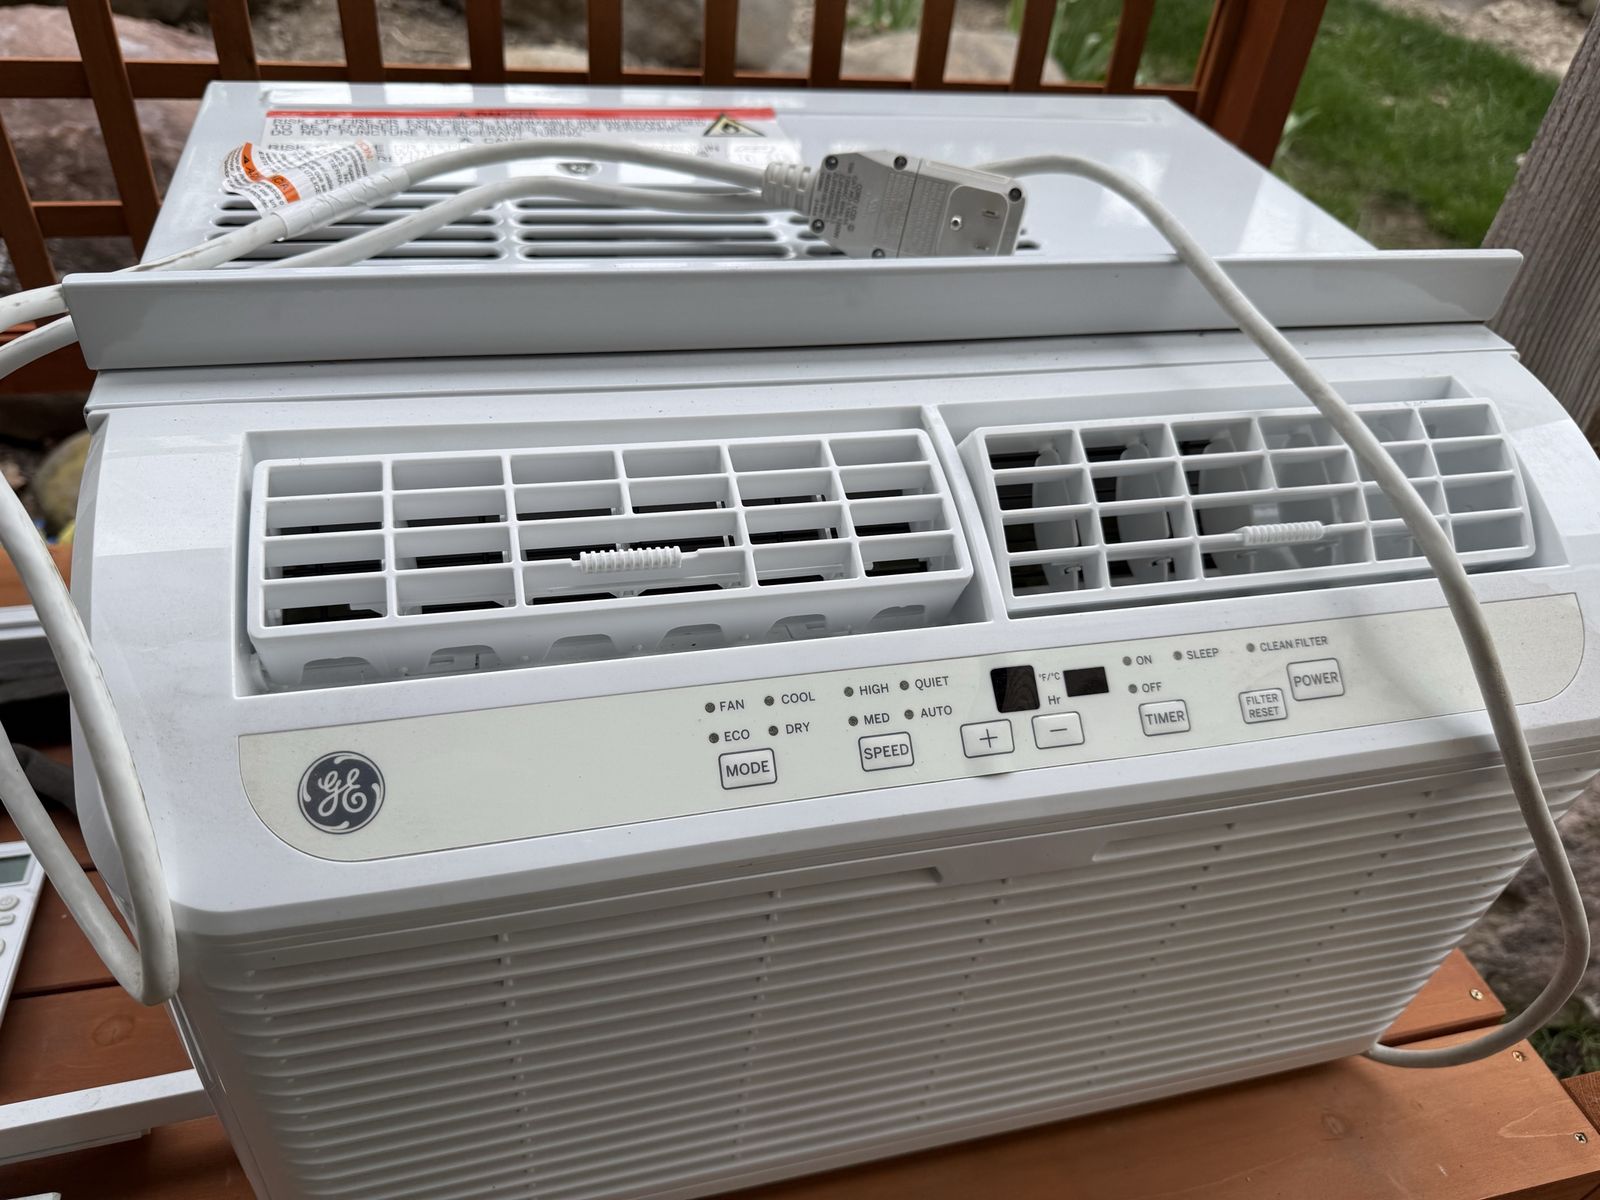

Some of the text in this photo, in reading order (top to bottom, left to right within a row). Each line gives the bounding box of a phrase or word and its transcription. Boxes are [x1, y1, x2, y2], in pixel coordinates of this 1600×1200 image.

[1260, 636, 1328, 652] CLEAN FILTER
[1136, 655, 1152, 666] ON
[1187, 648, 1219, 660] SLEEP
[915, 676, 949, 691] QUIET
[1293, 671, 1339, 687] POWER
[860, 683, 889, 696] HIGH
[1142, 682, 1162, 693] OFF
[781, 692, 815, 704] COOL
[1048, 695, 1061, 705] Hr
[1246, 694, 1279, 705] FILTER
[719, 700, 745, 712] FAN
[920, 705, 952, 718] AUTO
[1249, 706, 1279, 718] RESET
[864, 713, 890, 725] MED
[1145, 711, 1185, 725] TIMER
[786, 722, 810, 735] DRY
[724, 729, 750, 742] ECO
[864, 744, 909, 760] SPEED
[726, 760, 770, 777] MODE
